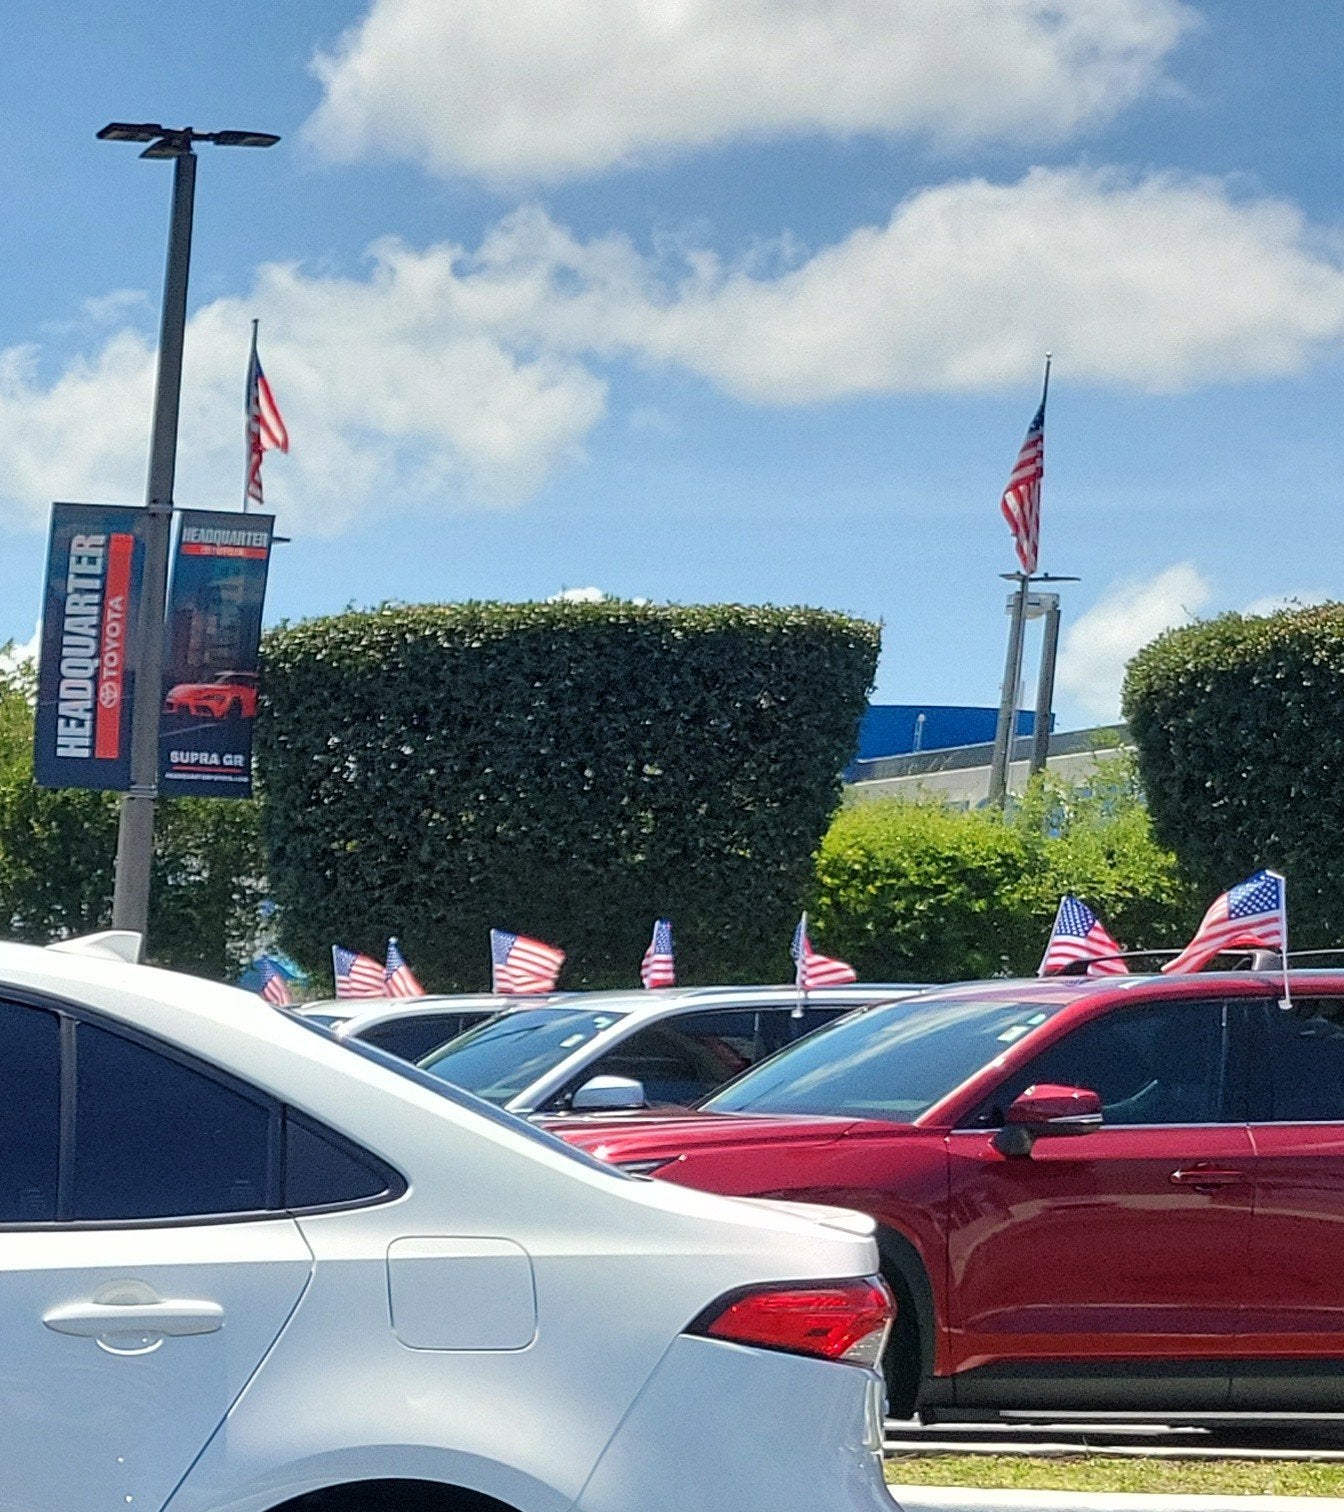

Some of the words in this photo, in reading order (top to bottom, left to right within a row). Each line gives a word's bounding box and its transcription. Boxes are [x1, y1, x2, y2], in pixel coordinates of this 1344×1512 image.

[57, 534, 106, 757] HEADQUARTER
[103, 597, 123, 680] TOYOTA
[170, 750, 220, 765] SUPRA
[223, 753, 244, 767] GR
